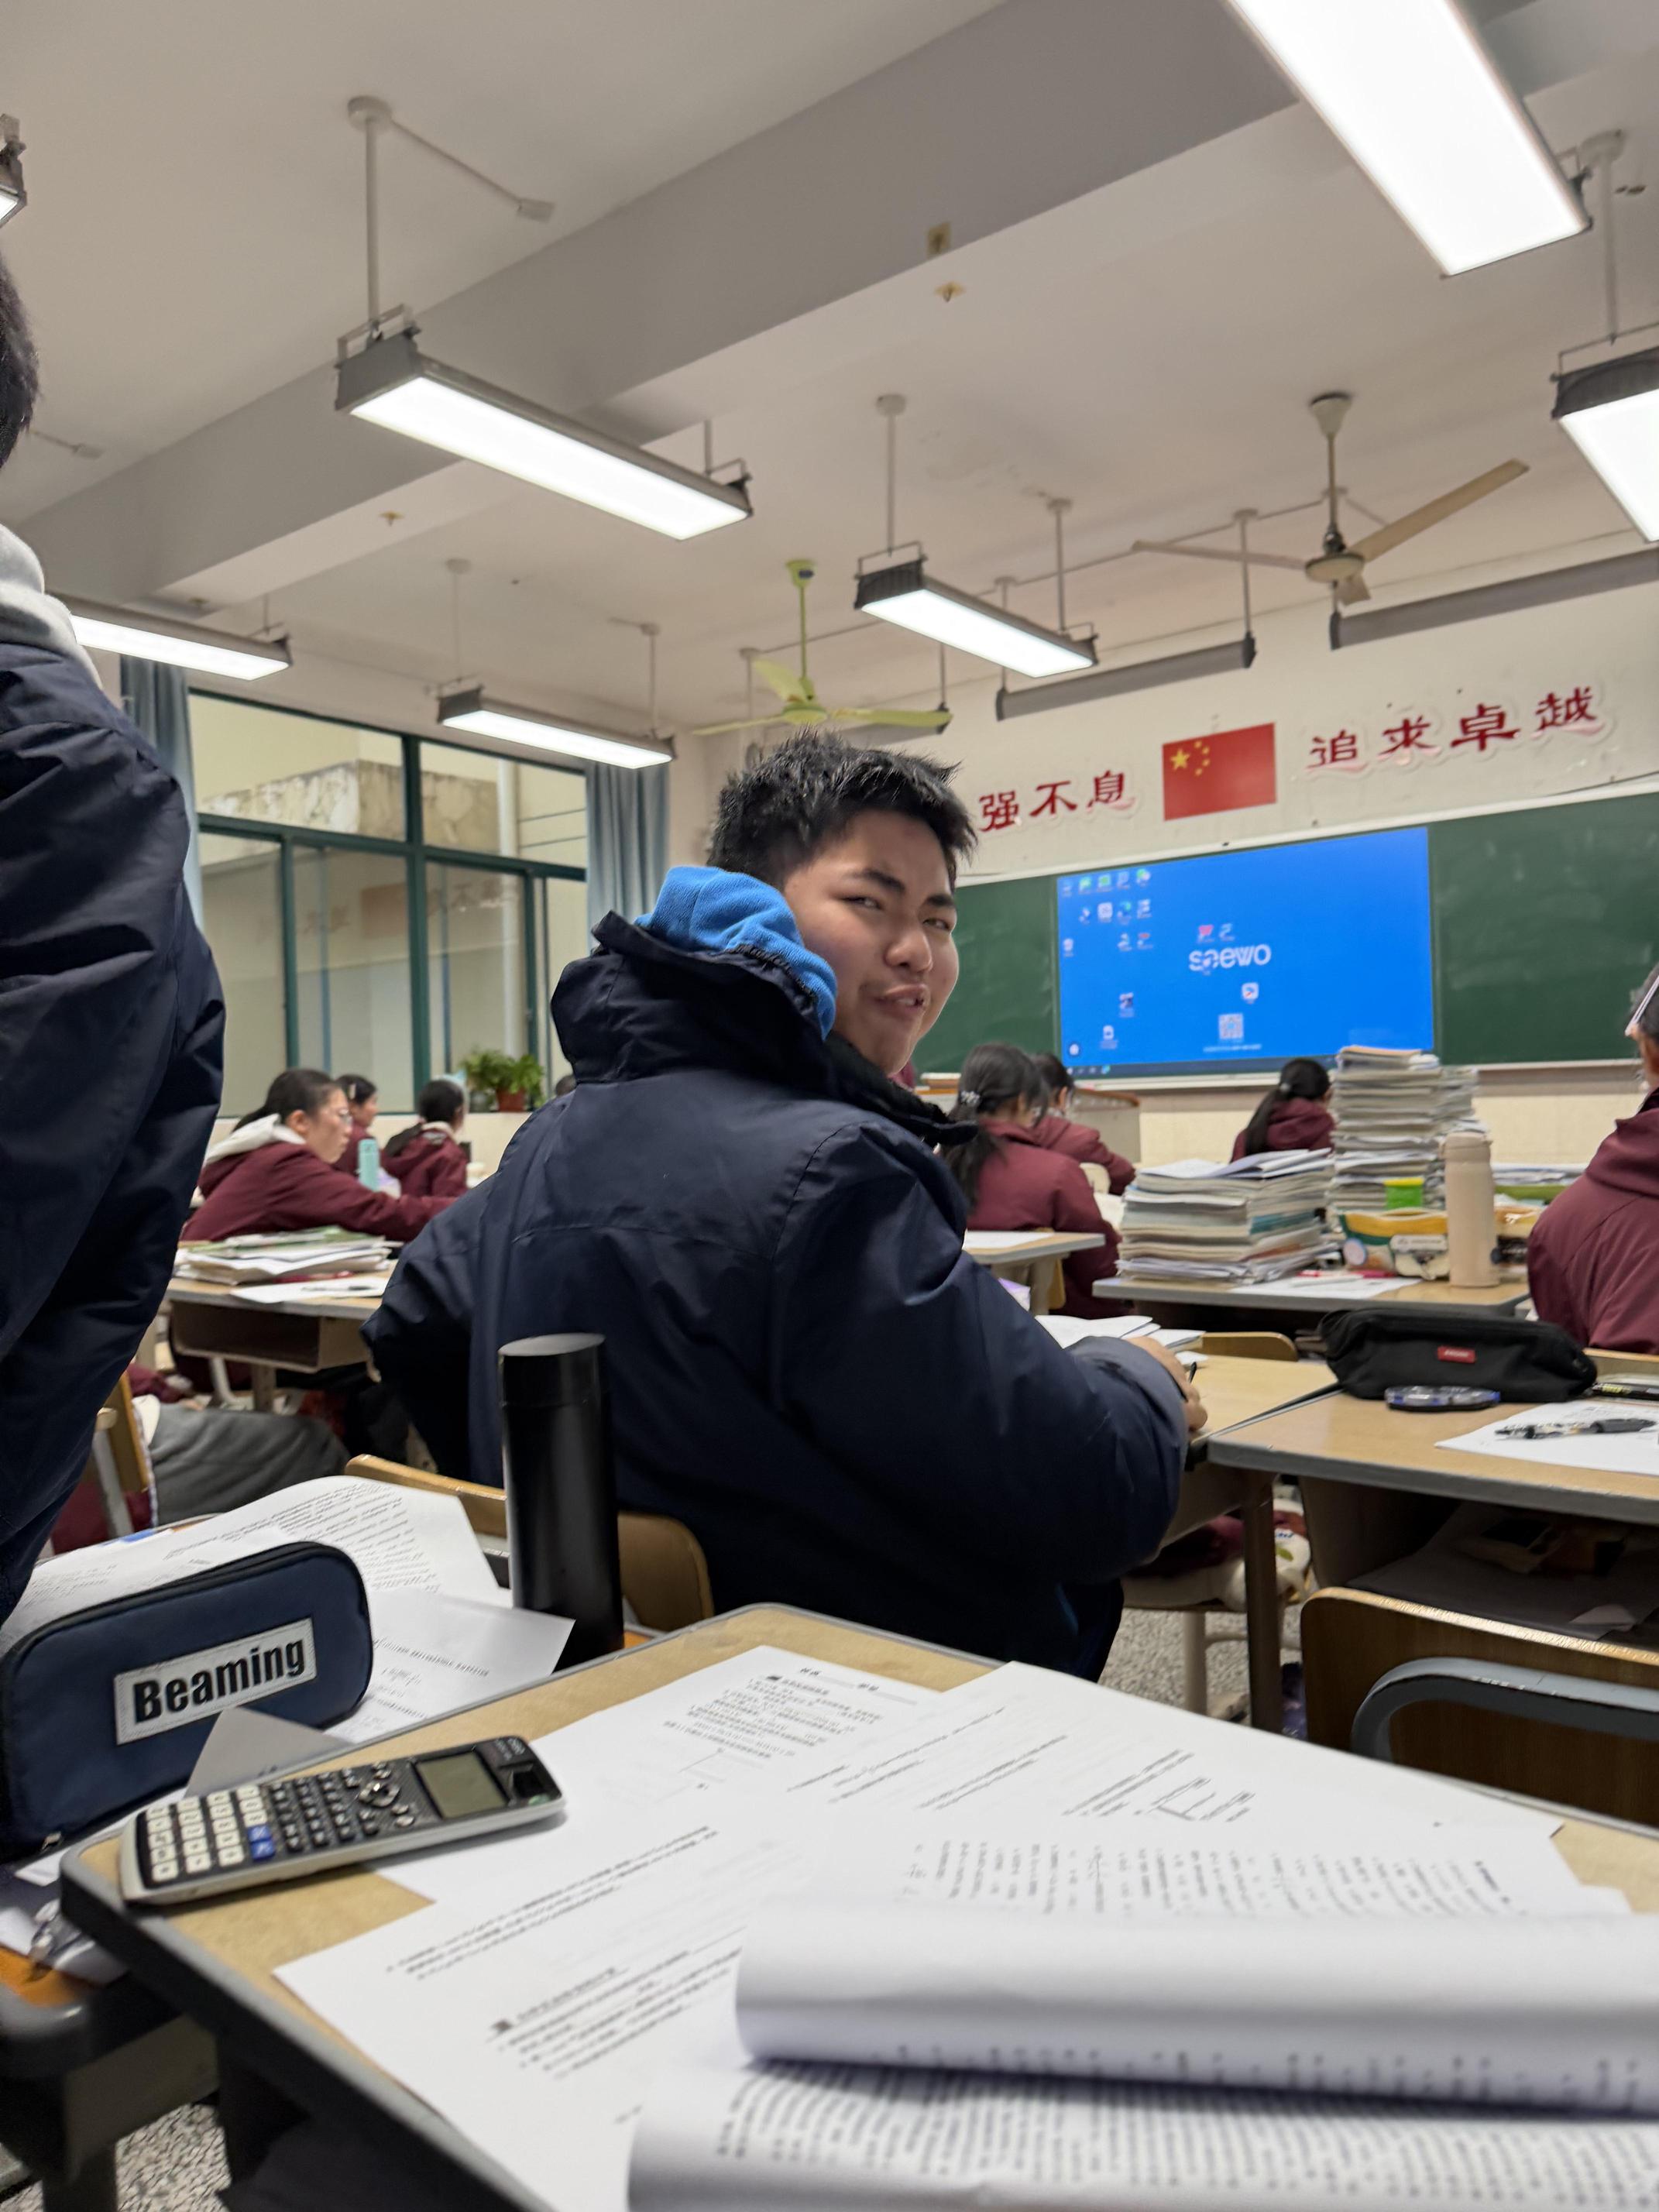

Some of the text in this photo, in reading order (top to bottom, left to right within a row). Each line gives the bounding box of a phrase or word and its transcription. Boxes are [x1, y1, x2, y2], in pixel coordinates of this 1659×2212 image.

[1305, 685, 1602, 771] 追求卓越
[978, 770, 1134, 832] 强不息
[133, 1639, 305, 1724] Beaming
